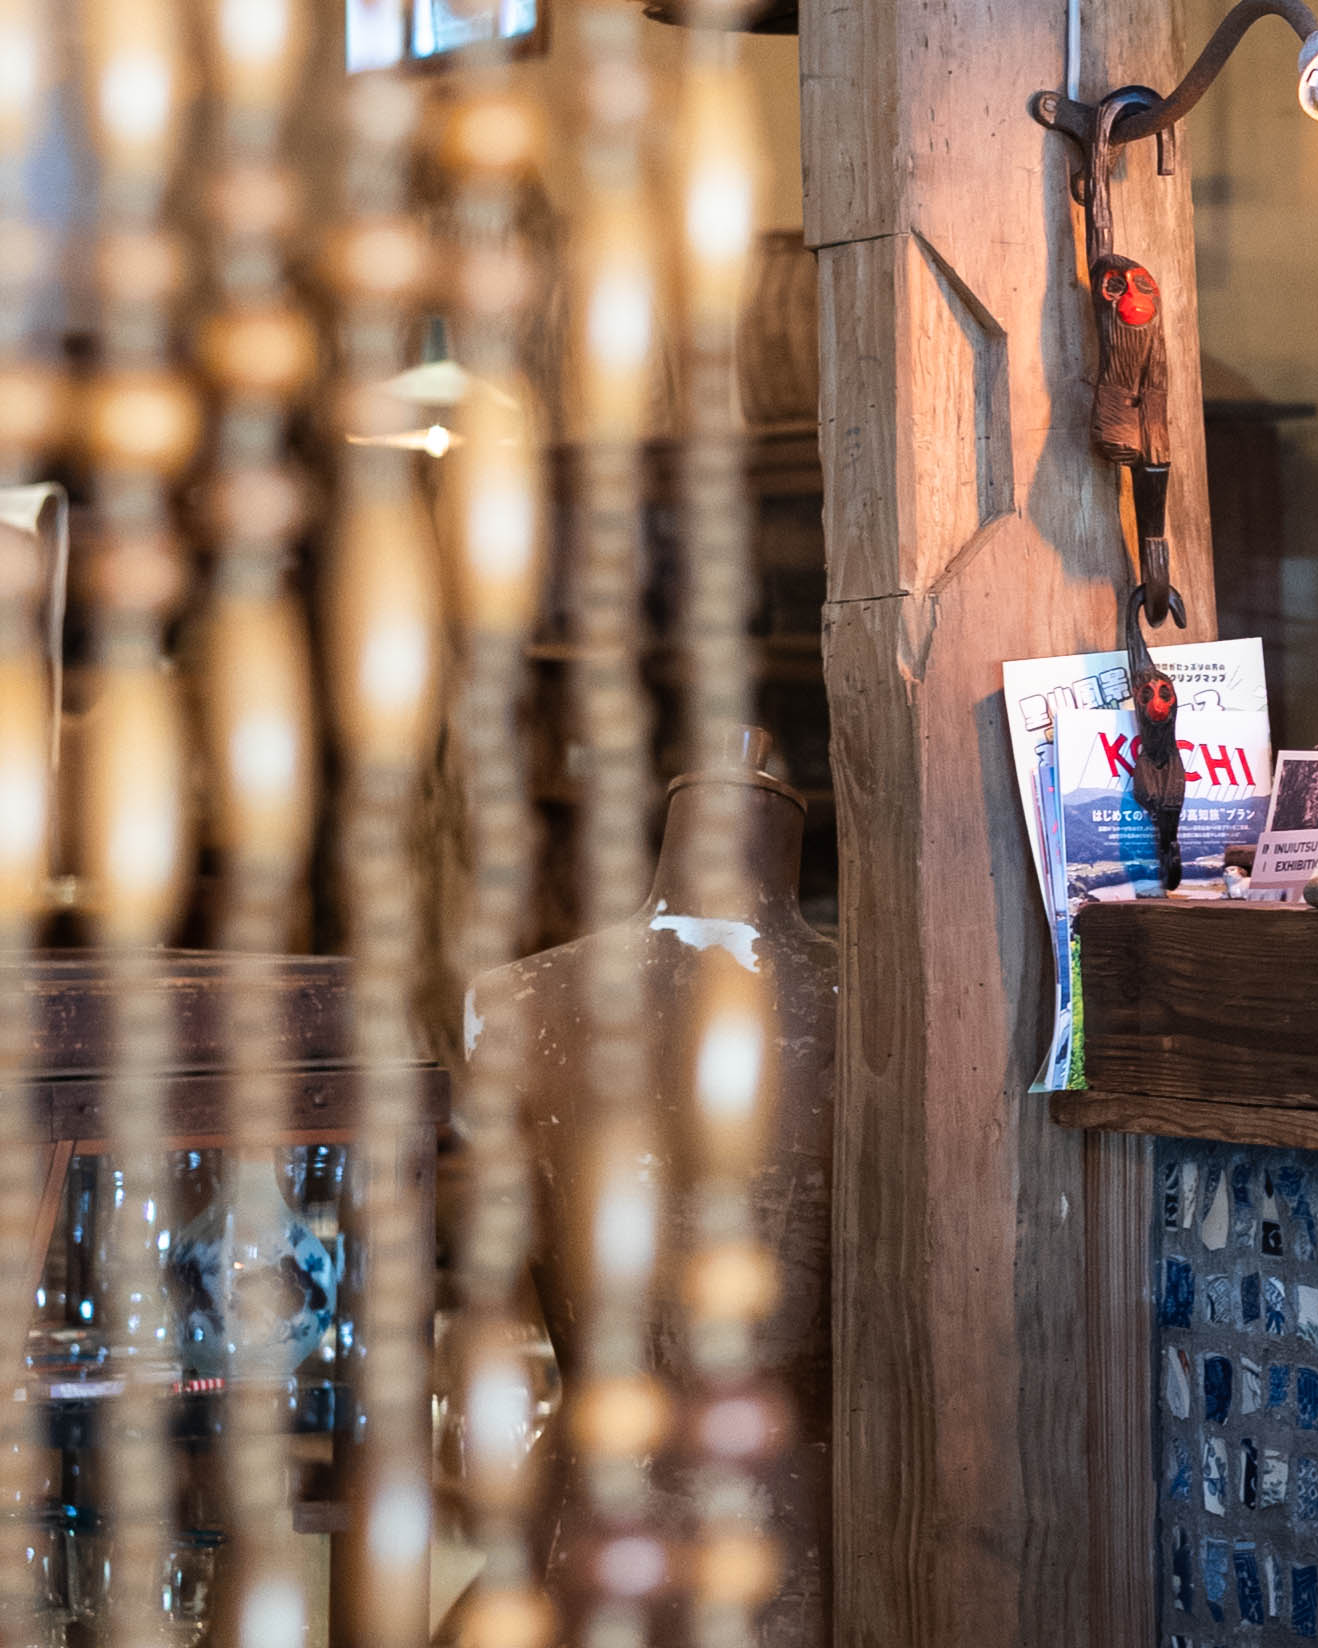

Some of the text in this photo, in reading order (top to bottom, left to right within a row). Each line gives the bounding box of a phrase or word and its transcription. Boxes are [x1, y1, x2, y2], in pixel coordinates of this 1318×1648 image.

[1169, 673, 1226, 683] クリングマップ
